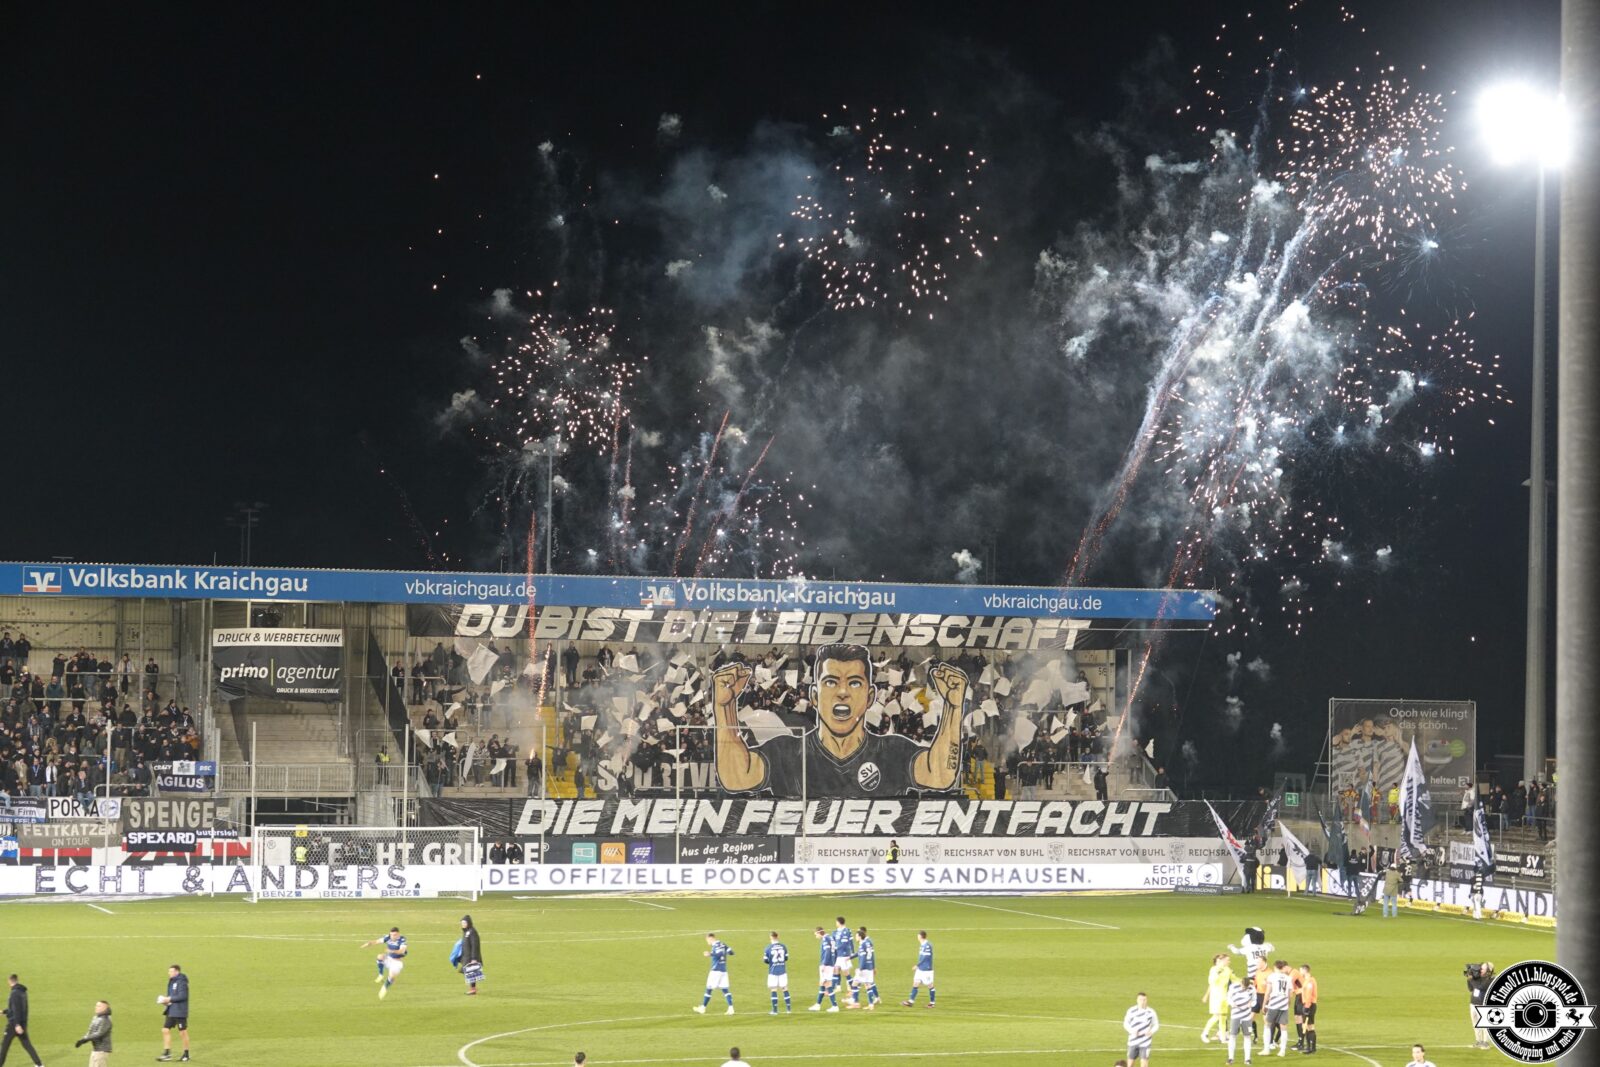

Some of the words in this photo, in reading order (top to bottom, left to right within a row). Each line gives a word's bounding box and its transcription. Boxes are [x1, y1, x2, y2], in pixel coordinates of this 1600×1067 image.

[69, 568, 187, 590] Volksbank
[194, 571, 308, 596] Kraichgau
[405, 580, 537, 600] vbkraichgau.de
[682, 582, 787, 603] Volksbank
[795, 586, 896, 609] Kraichgau
[983, 593, 1102, 613] vbkraichgau.de
[454, 603, 529, 638] DU
[535, 605, 654, 643] BIST
[658, 610, 739, 644] DIE
[741, 611, 1092, 650] LEIDENSCHAFT
[217, 633, 251, 643] DRUCK
[253, 633, 261, 642] &
[264, 633, 341, 643] WERBETECHNIK
[220, 663, 269, 682] primo
[276, 664, 340, 683] agentur
[1420, 709, 1438, 718] wie
[1440, 708, 1469, 721] klingt
[1399, 720, 1417, 729] das
[860, 764, 874, 778] SV
[156, 775, 205, 789] AGILUS
[50, 799, 100, 817] PORA
[129, 801, 215, 829] SPENGE
[514, 799, 605, 835] DIE
[610, 799, 734, 835] MEIN
[736, 799, 901, 835] FEUER
[909, 799, 1172, 836] ENTFACHT
[22, 823, 117, 837] FETTKATZEN
[51, 838, 64, 847] ON
[66, 837, 91, 846] TOUR
[128, 832, 196, 845] SPEXARD
[681, 847, 699, 857] Aus
[703, 844, 720, 855] der
[722, 843, 754, 855] Region
[817, 849, 869, 857] REICHSRAT
[944, 849, 995, 857] REICHSRAT
[996, 849, 1017, 857] VON
[1067, 849, 1117, 857] REICHSRAT
[1119, 849, 1139, 857] VON
[723, 855, 738, 864] die
[742, 851, 778, 864] Region!
[1152, 865, 1183, 874] ECHT
[1186, 864, 1193, 873] &
[35, 865, 153, 893] ECHT
[182, 865, 205, 893] &
[226, 864, 420, 893] ANDERS.
[488, 868, 538, 886] DER
[549, 868, 694, 885] OFFIZIELLE
[704, 867, 821, 885] PODCAST
[830, 867, 875, 884] DES
[885, 867, 914, 884] SV
[923, 867, 1092, 884] SANDHAUSEN.
[262, 890, 293, 898] BENZ
[323, 890, 353, 898] BENZ
[770, 949, 786, 962] 23
[1278, 980, 1288, 992] 14
